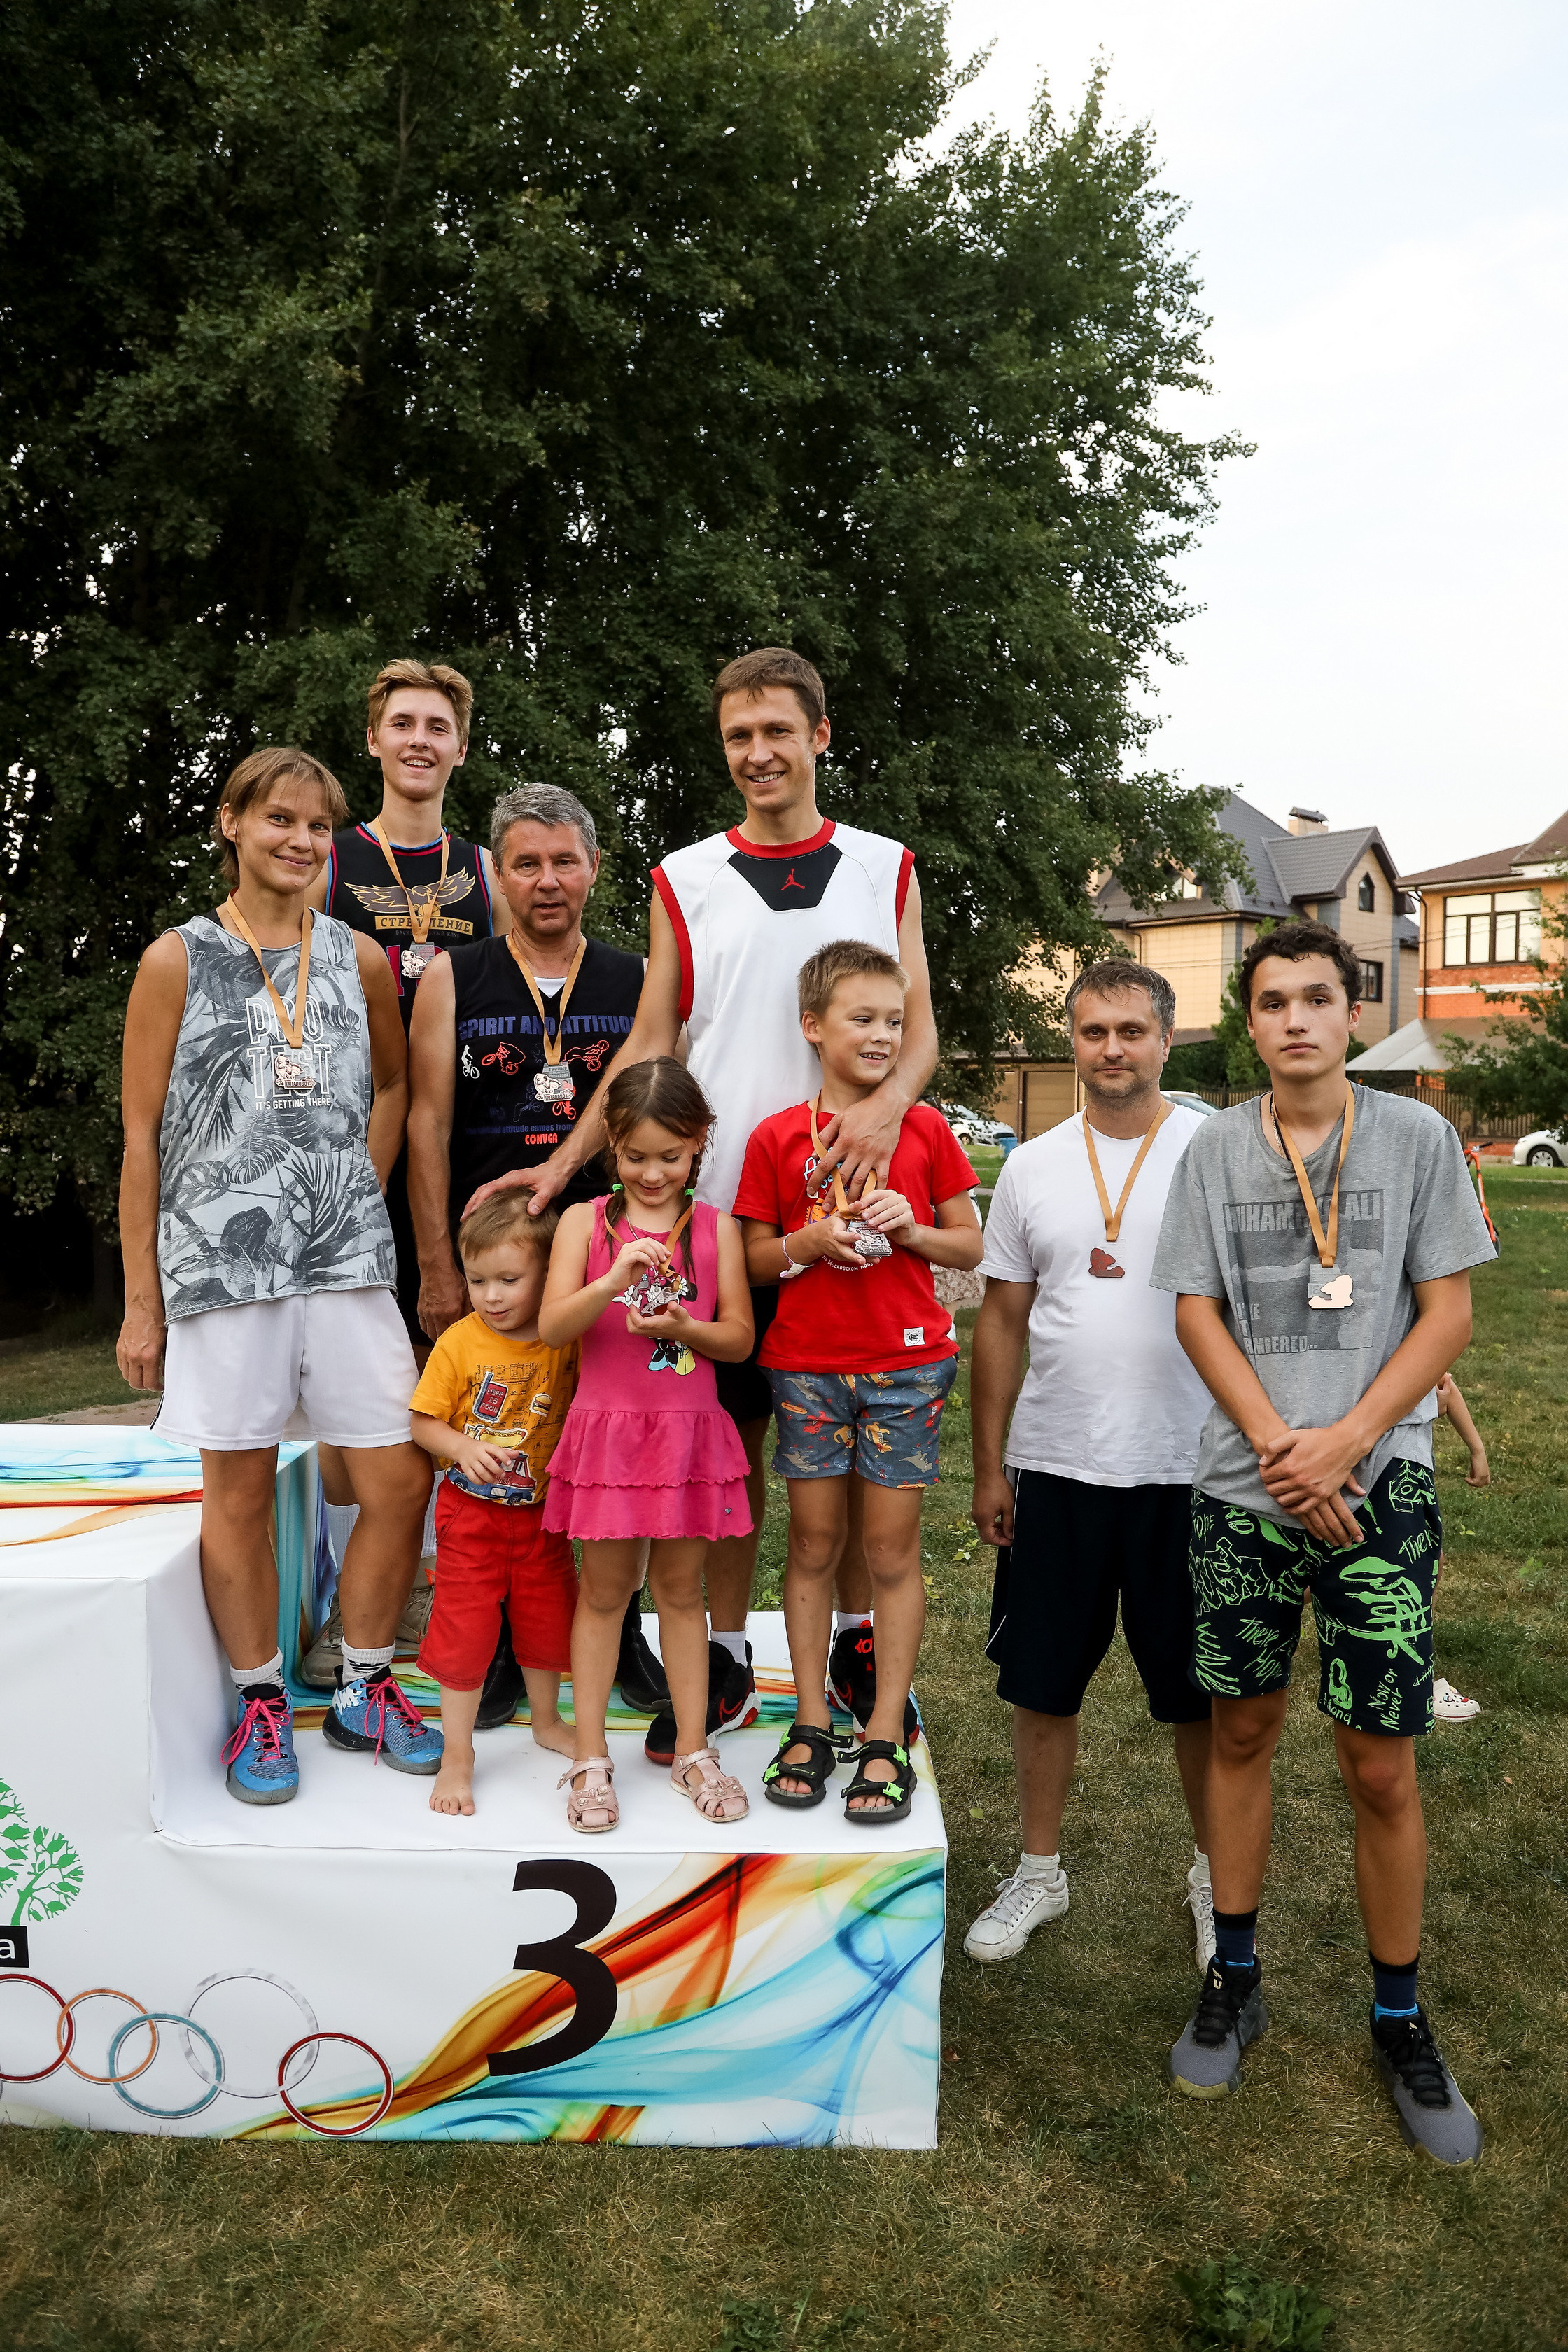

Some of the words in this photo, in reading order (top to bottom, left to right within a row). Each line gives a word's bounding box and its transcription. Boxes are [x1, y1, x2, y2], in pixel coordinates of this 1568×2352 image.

[458, 1016, 516, 1040] SPIRIT
[520, 1015, 556, 1036] AND
[561, 1015, 636, 1035] ATTITUD
[255, 1100, 271, 1111] IT'S
[272, 1098, 305, 1110] GETTING
[307, 1097, 330, 1107] THERE
[530, 1124, 554, 1132] cames
[524, 1133, 558, 1145] CONVER
[1344, 1192, 1380, 1221] ALI
[876, 1235, 883, 1244] 3
[1367, 1680, 1391, 1711] Now
[1384, 1667, 1398, 1684] or
[486, 1858, 618, 2077] 3
